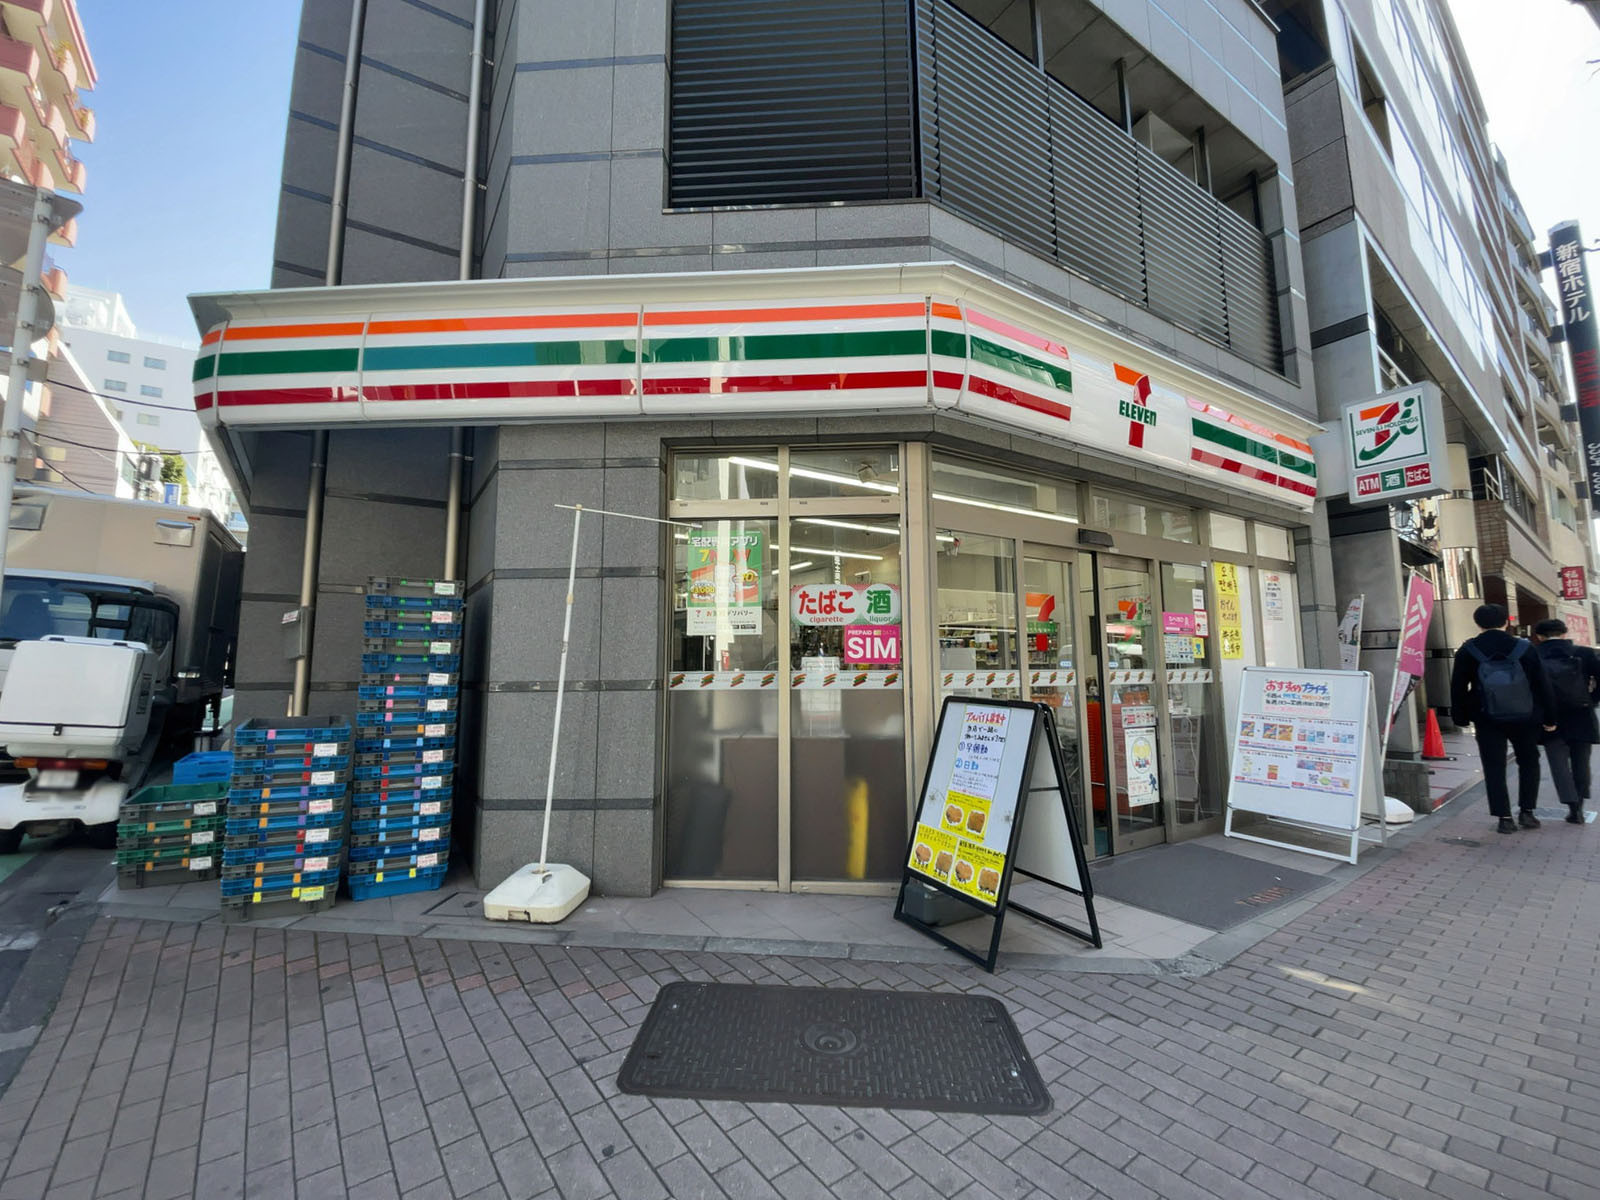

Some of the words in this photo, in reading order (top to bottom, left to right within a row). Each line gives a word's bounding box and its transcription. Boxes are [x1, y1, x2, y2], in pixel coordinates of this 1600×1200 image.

[1556, 240, 1590, 324] 新宿ホテル
[1385, 473, 1401, 487] 酒
[1406, 468, 1431, 483] たばこ
[1359, 477, 1380, 492] ATM
[798, 589, 855, 615] たばこ
[866, 589, 891, 614] 酒
[809, 616, 844, 625] cigarette
[869, 615, 892, 624] liquor
[847, 637, 897, 659] SIM
[1266, 680, 1302, 693] おすすめ
